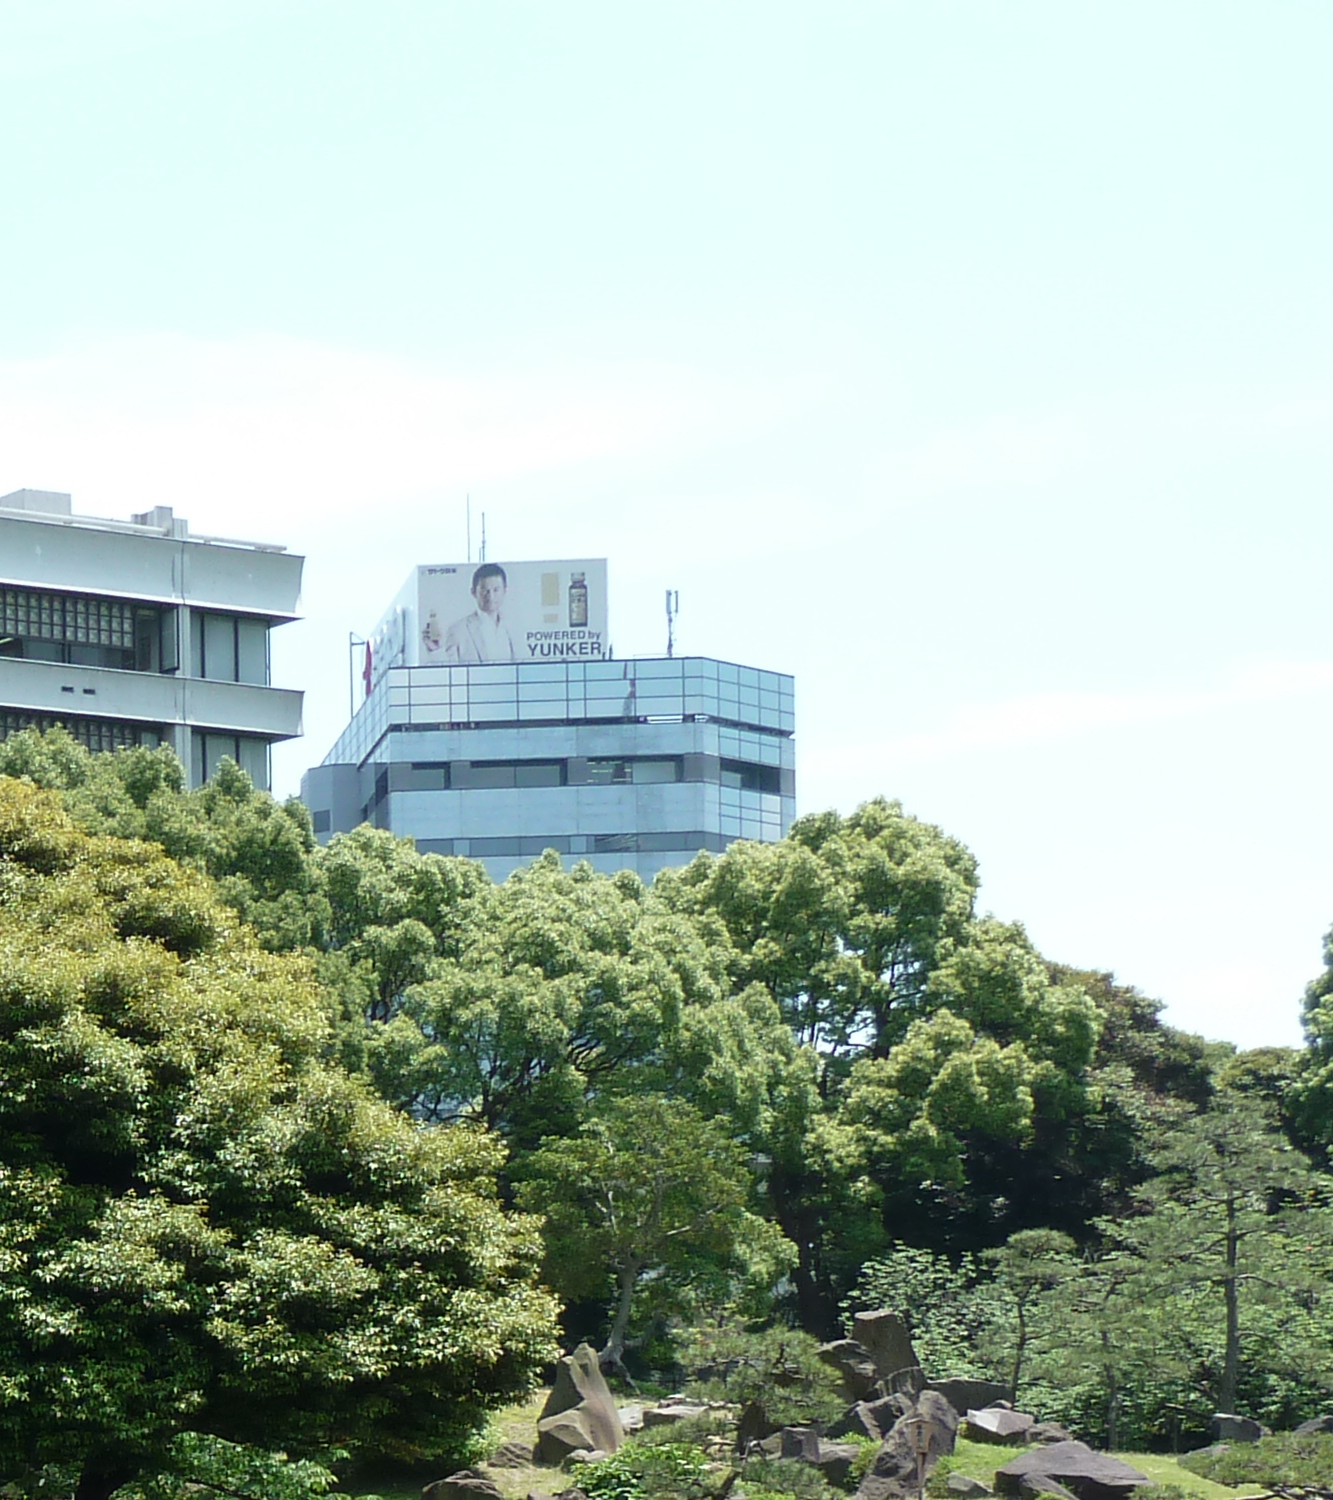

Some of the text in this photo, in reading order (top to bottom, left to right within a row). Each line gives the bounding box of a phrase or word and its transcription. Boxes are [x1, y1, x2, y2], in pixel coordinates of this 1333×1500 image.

[527, 630, 601, 641] POWERED by
[528, 642, 601, 656] YUNKER
